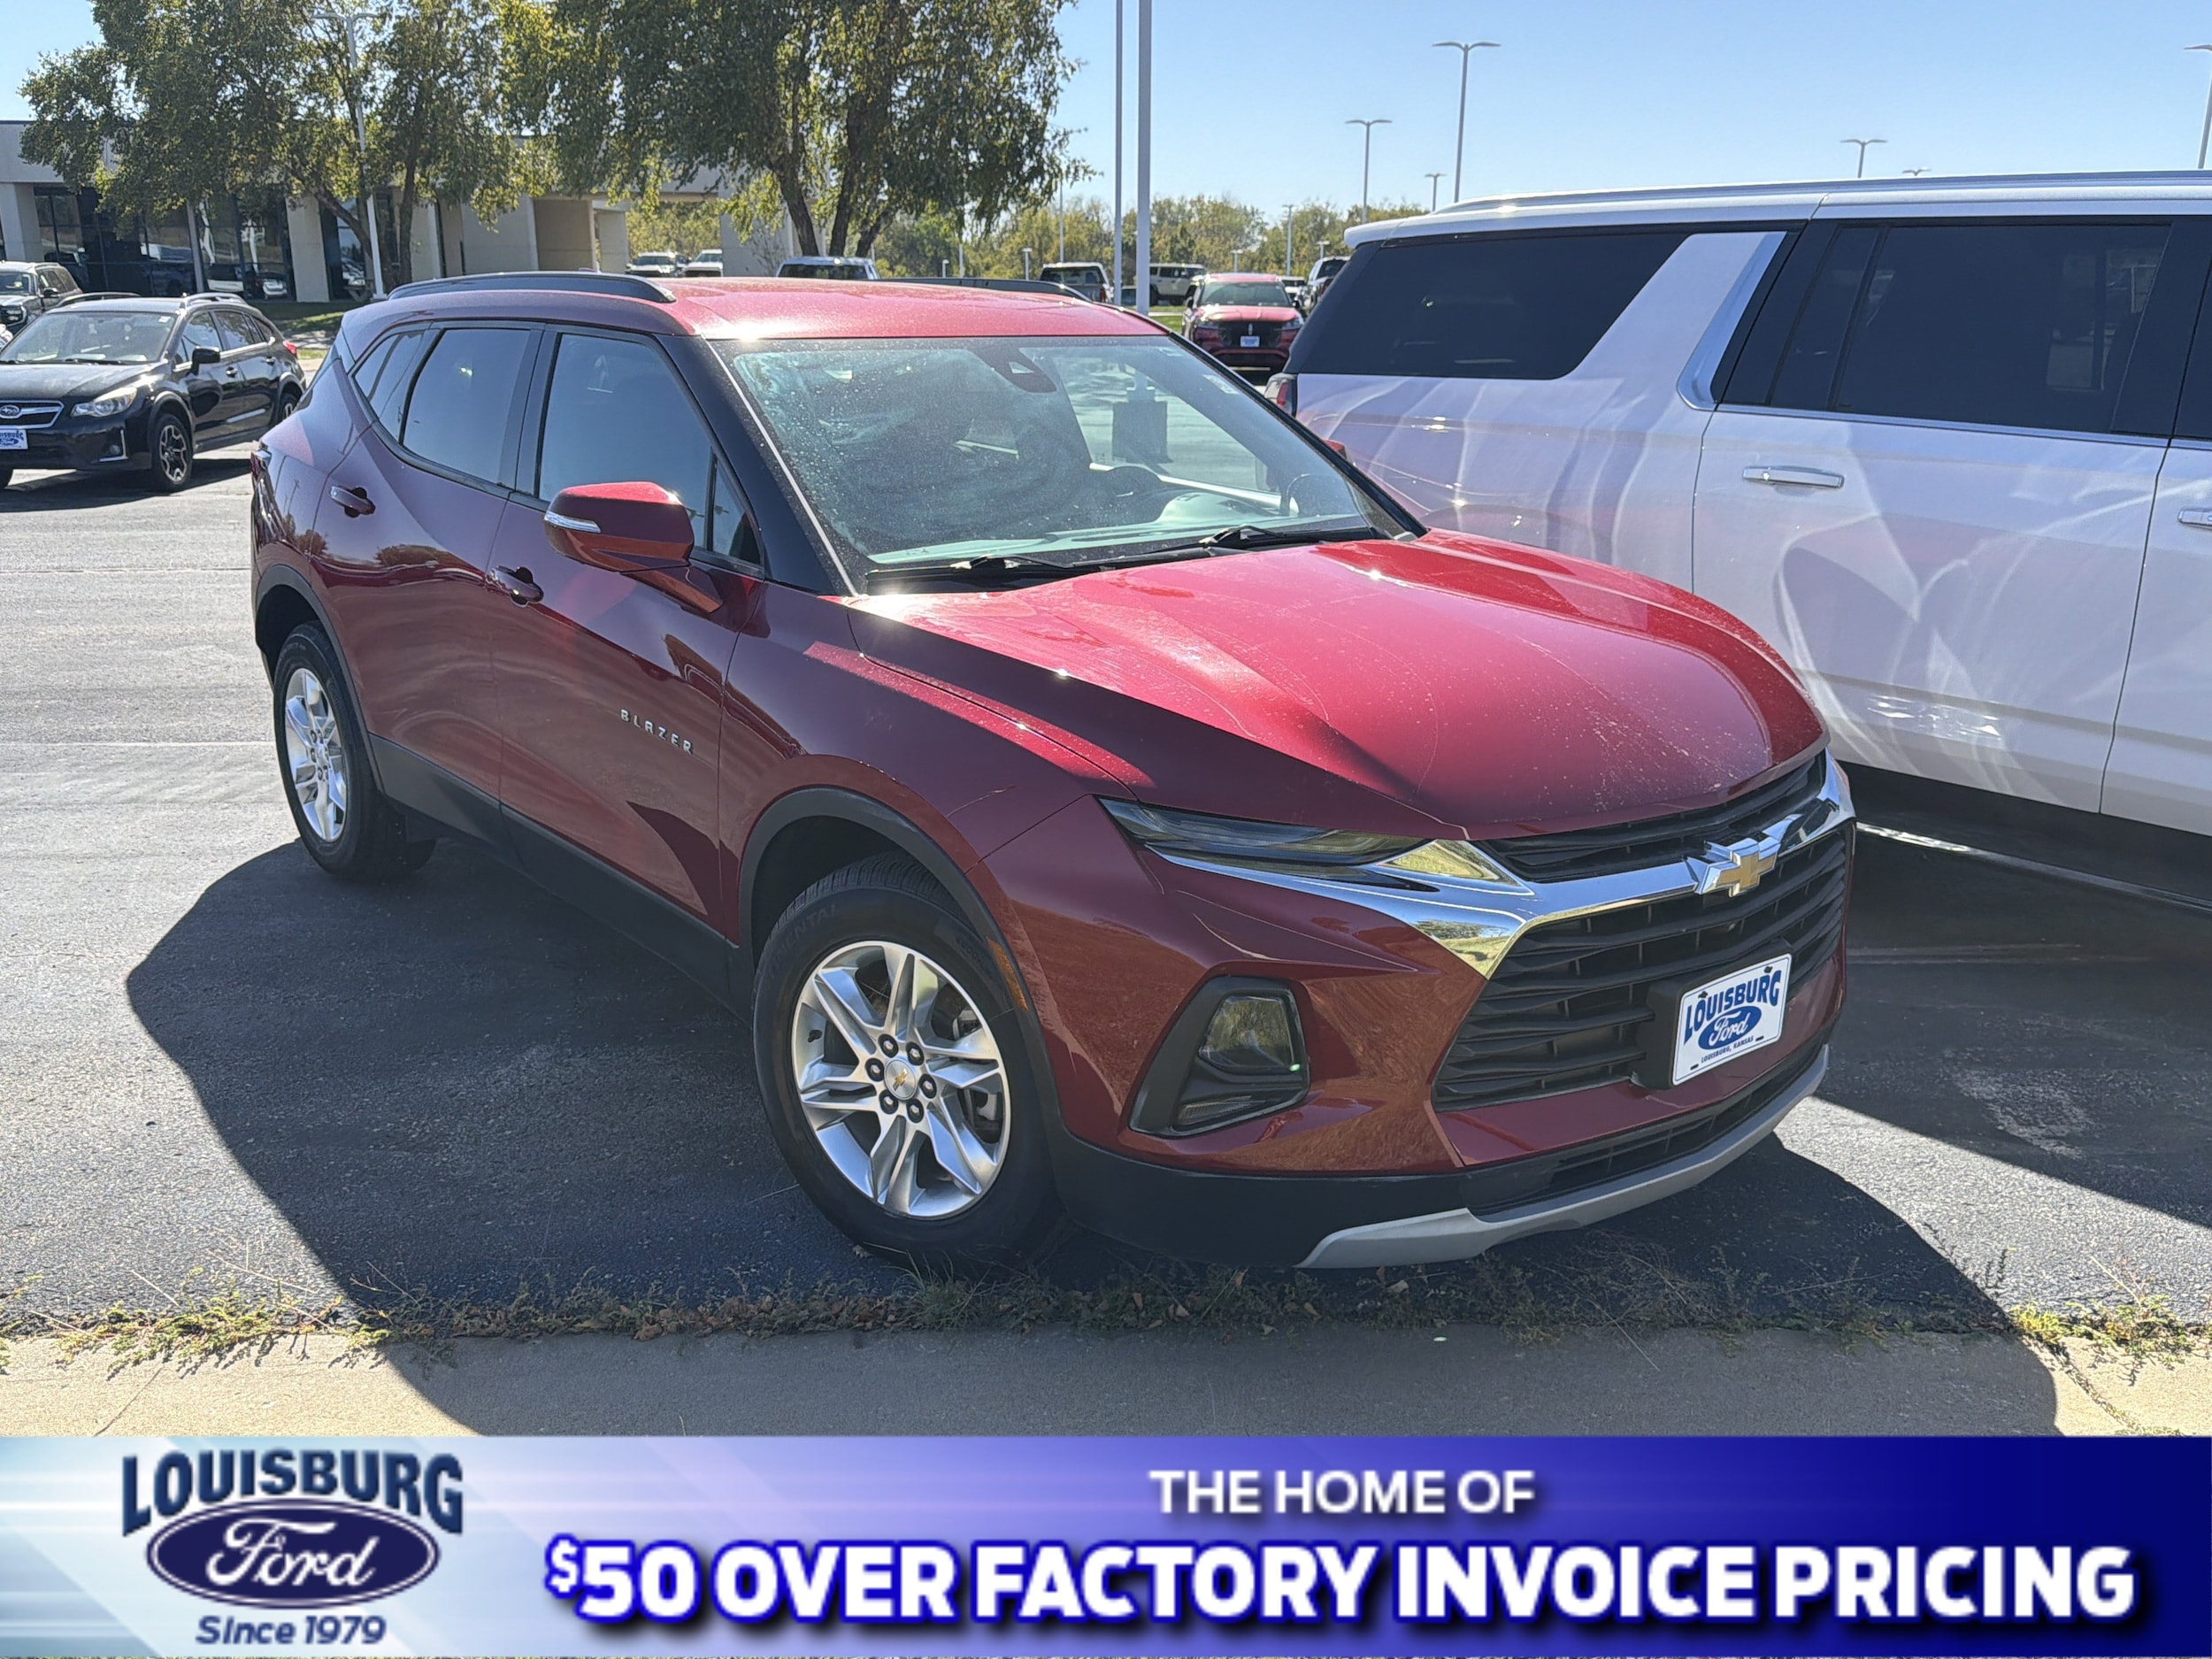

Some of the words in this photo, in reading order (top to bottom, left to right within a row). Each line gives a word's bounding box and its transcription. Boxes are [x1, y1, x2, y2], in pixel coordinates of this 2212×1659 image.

[620, 709, 694, 756] BLAZER
[1684, 970, 1782, 1047] LOUISBURG
[1709, 1010, 1751, 1047] Ford
[1701, 1046, 1732, 1064] LOUISBURG,
[1732, 1035, 1754, 1049] KANSAS
